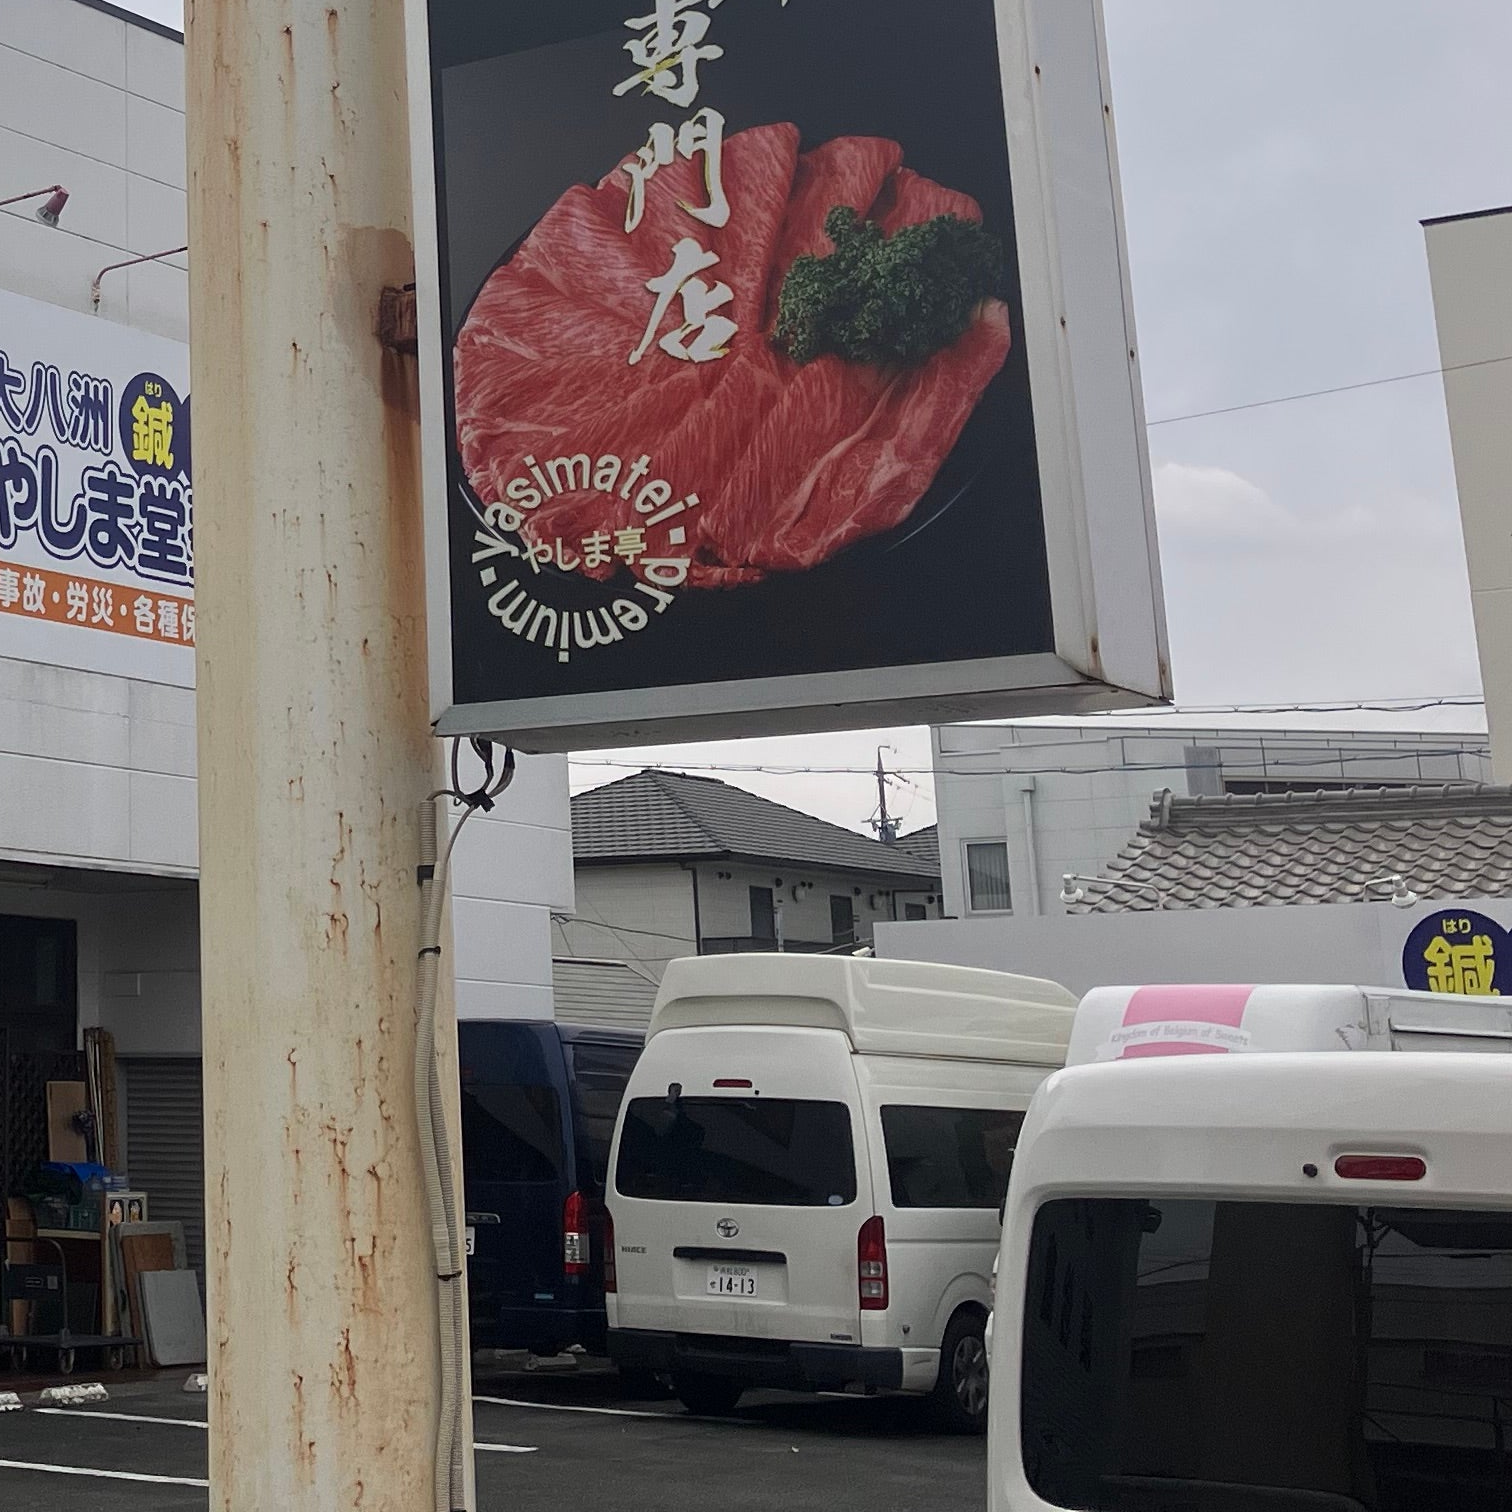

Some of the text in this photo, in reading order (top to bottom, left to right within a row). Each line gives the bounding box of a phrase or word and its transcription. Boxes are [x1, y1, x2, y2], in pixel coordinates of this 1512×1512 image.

[144, 380, 162, 398] はり
[131, 395, 174, 470] 鍼
[471, 453, 700, 564] yasimatei
[521, 526, 647, 574] やしま亭
[488, 557, 691, 663] premium
[1442, 918, 1472, 934] はり
[1423, 934, 1501, 996] 鍼
[719, 1276, 755, 1294] 14-13
